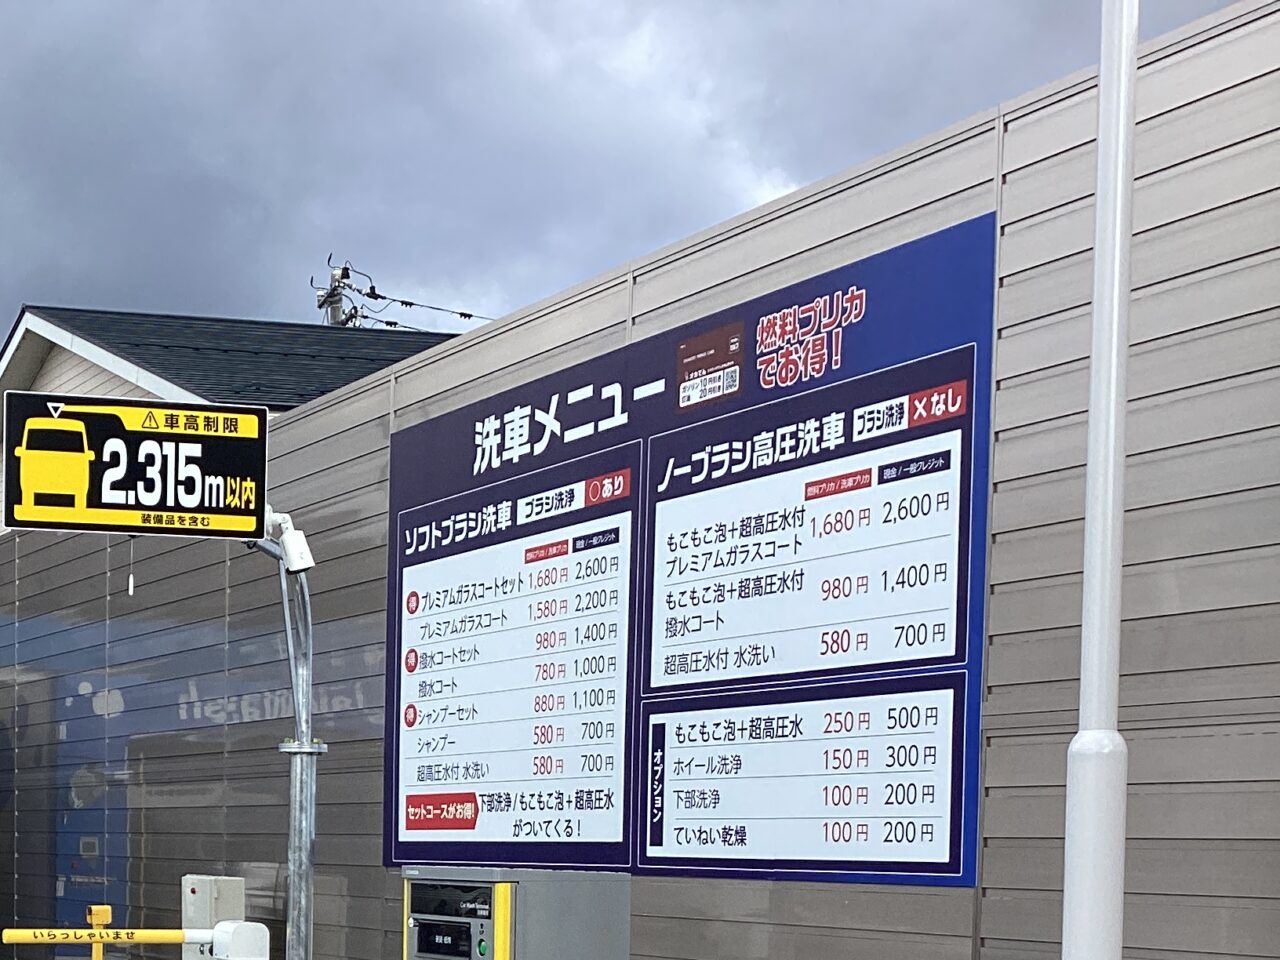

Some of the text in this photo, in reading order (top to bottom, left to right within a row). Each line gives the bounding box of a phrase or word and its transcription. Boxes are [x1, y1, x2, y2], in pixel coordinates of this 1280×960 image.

[756, 285, 867, 355] 燃料プリカ
[756, 328, 843, 390] でお得！
[164, 413, 239, 434] 車高制限
[473, 377, 666, 476] 洗車メニュー
[657, 411, 845, 493] ノーブラシ高圧洗車
[857, 403, 905, 434] ブラシ洗浄
[140, 512, 211, 528] 装備品を含む
[405, 500, 513, 556] ソフトブラシ洗車
[524, 488, 576, 519] ブラシ洗浄
[810, 507, 871, 539] 1,680円
[882, 491, 950, 525] 2,600円
[665, 534, 803, 579] プレミアムガラスコート
[420, 571, 524, 614] プレミアムガラスコートセット
[527, 567, 569, 591] 1,680円
[575, 555, 619, 581] 2,600円
[820, 575, 869, 602] 980円
[880, 562, 948, 593] 1,400円
[419, 588, 619, 641] プレミアムガラスコート 1,580円 2,200円
[664, 610, 725, 639] 撥水コート
[418, 644, 480, 671] 撥水コートセット
[535, 630, 567, 651] 980円
[574, 622, 618, 645] 1,400円
[663, 622, 946, 676] 超高圧水付 水洗い 580円 700円
[418, 655, 617, 699] 撥水コート 780円 1,000円
[417, 703, 479, 726] シャンプーセット
[533, 694, 566, 713] 880円
[572, 688, 616, 710] 1,100円
[822, 711, 871, 735] 250円
[886, 705, 939, 730] 500円
[417, 722, 615, 754] シャンプー 580円 700円
[416, 754, 614, 783] 超高圧水付 水洗い 580円 700円
[673, 744, 937, 776] ホイール洗浄 150円 300円
[652, 749, 664, 823] オプション
[673, 782, 935, 810] 下部洗浄 100円 200円
[407, 801, 475, 820] セットコースがお得!
[512, 818, 582, 838] がついてくる！
[673, 821, 934, 848] ていねい乾燥 100円 200円
[33, 930, 136, 941] いらっしゃいませ
